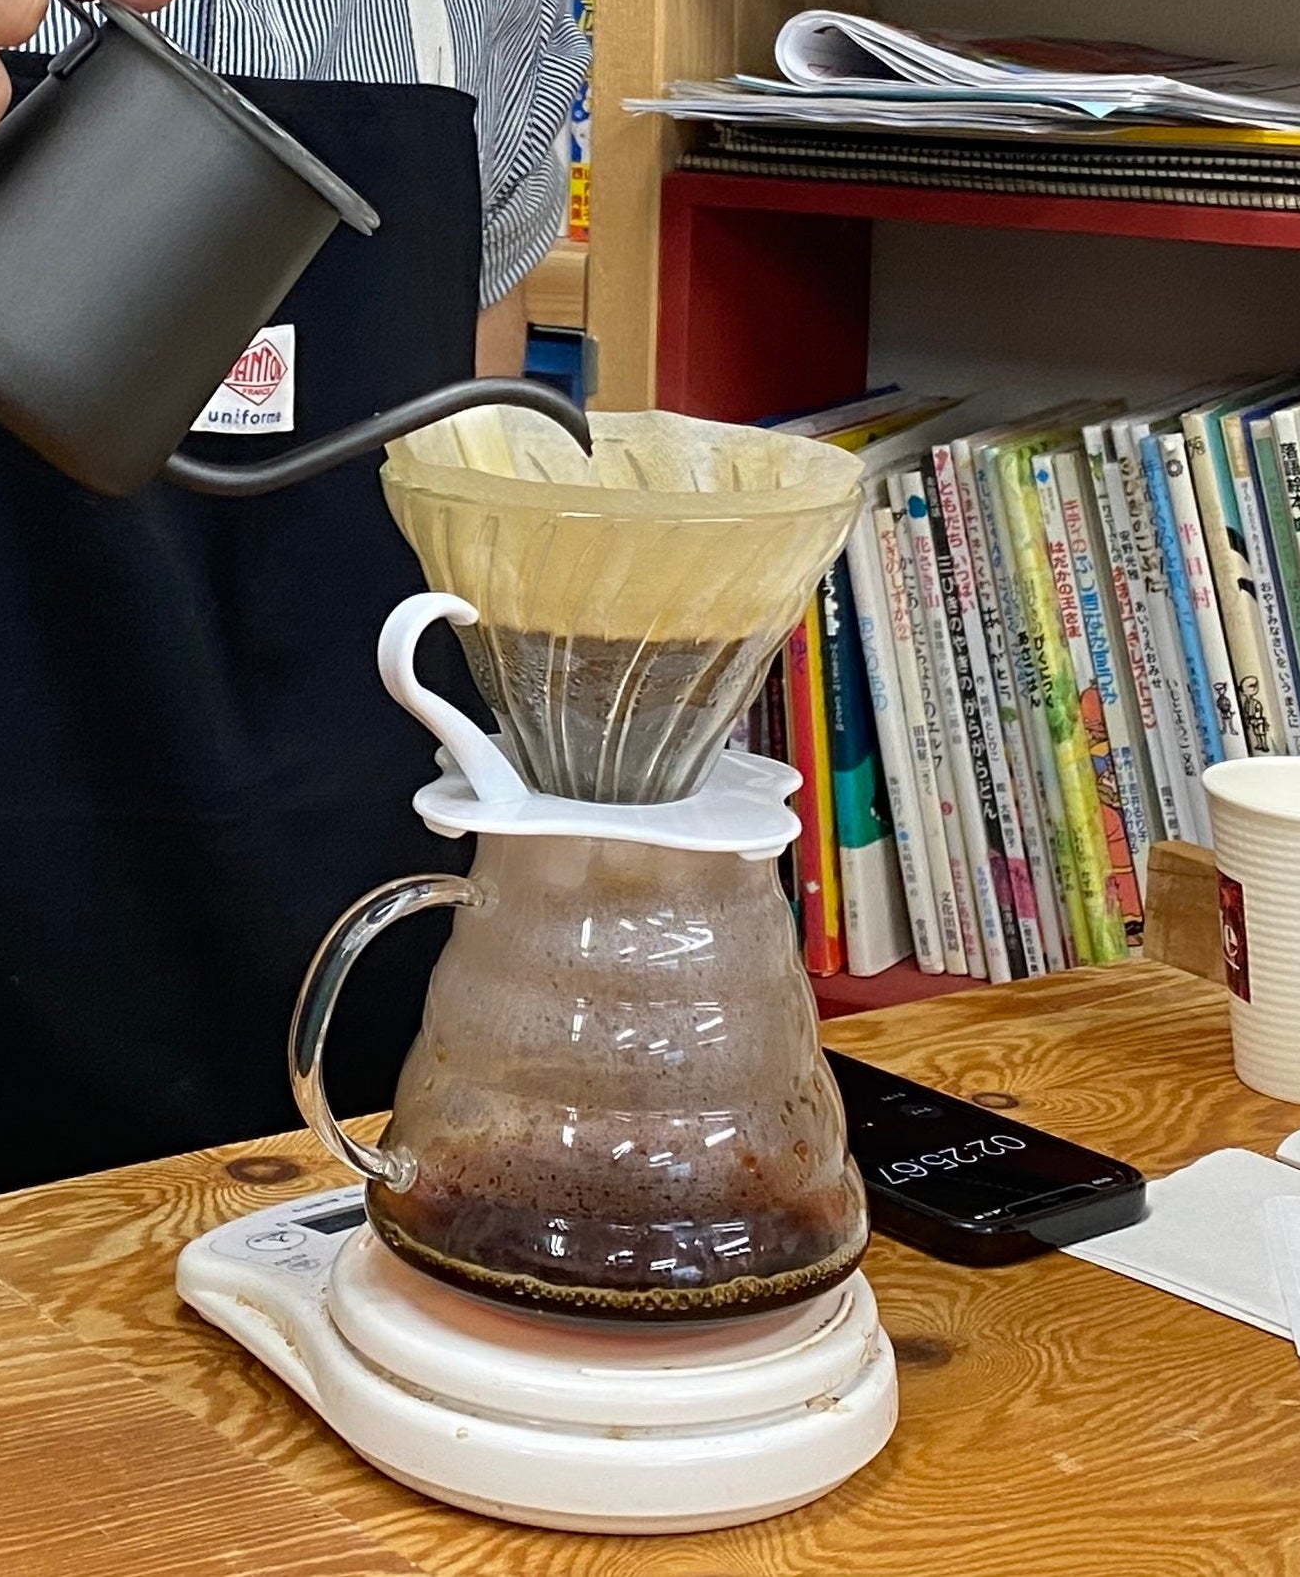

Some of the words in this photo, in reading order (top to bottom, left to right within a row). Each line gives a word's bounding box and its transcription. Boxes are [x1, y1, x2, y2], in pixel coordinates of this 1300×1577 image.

[913, 534, 941, 609] 花さき山
[939, 479, 965, 548] ともだち
[953, 553, 976, 614] いっぱい
[1049, 541, 1082, 638] はだかの王さま
[1179, 522, 1211, 610] 半日村
[936, 554, 998, 820] 三びきのやぎのがらがらどん
[1134, 600, 1163, 690] あいうえおみせ
[878, 1134, 1026, 1186] 02:25.67
